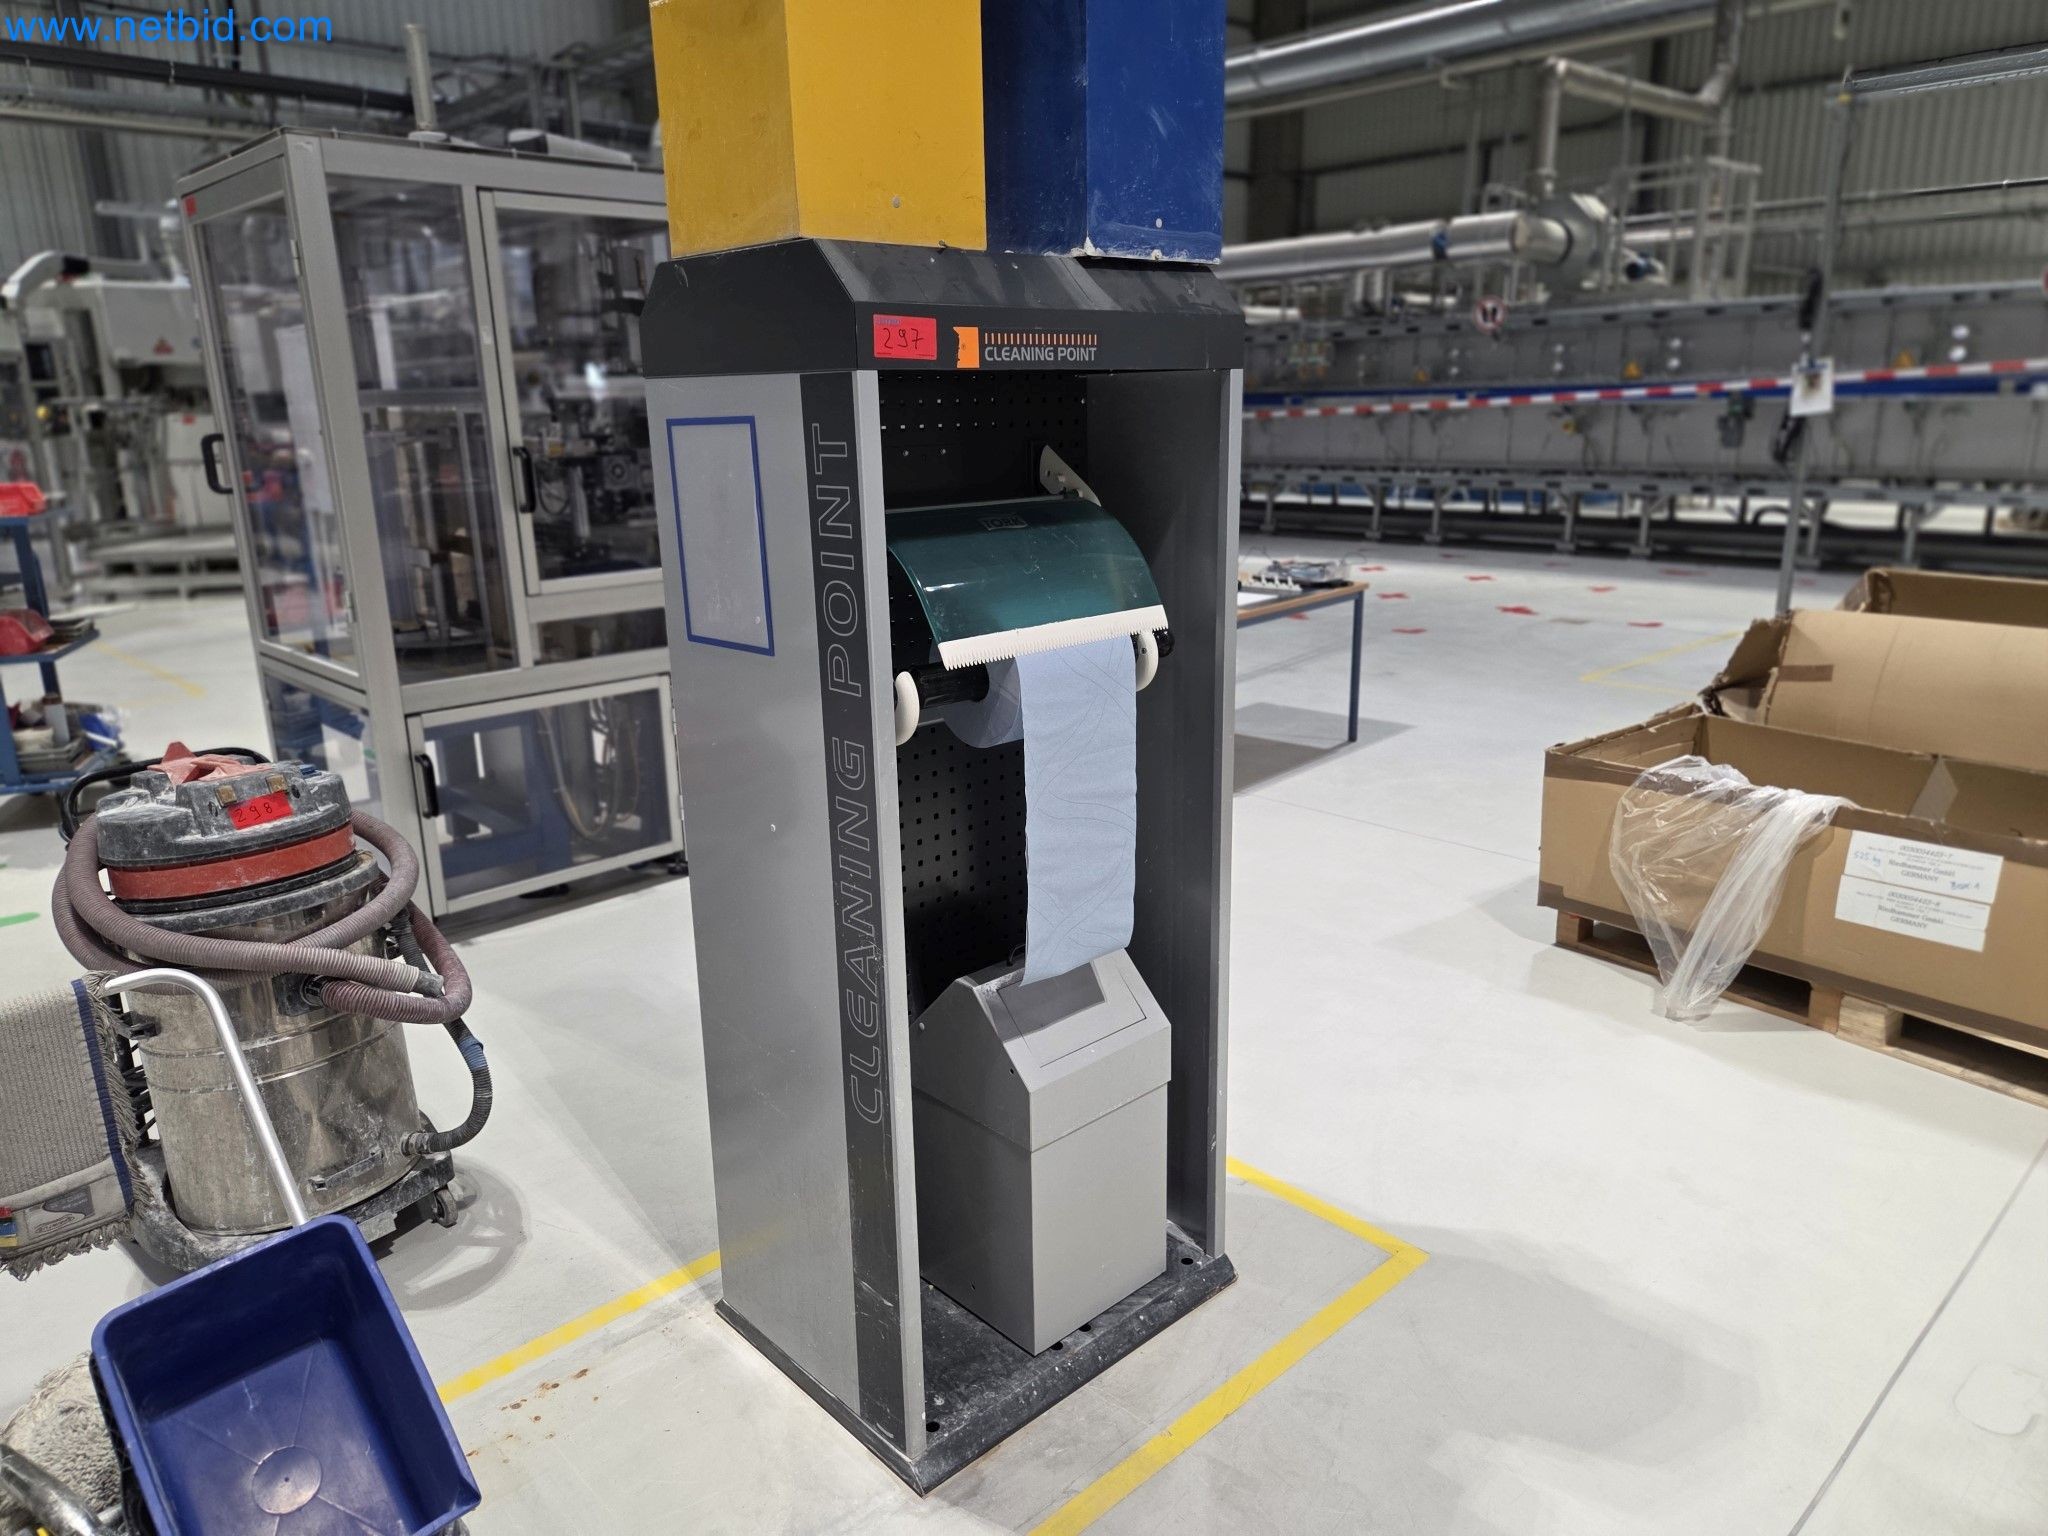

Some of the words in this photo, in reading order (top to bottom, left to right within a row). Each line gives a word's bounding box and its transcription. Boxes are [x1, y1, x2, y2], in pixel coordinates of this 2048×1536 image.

[883, 327, 924, 350] 297
[984, 346, 1054, 362] CLEANING
[1057, 347, 1097, 362] POINT
[812, 423, 862, 697] POINT
[234, 802, 273, 822] 298
[832, 736, 883, 1124] CLEANING
